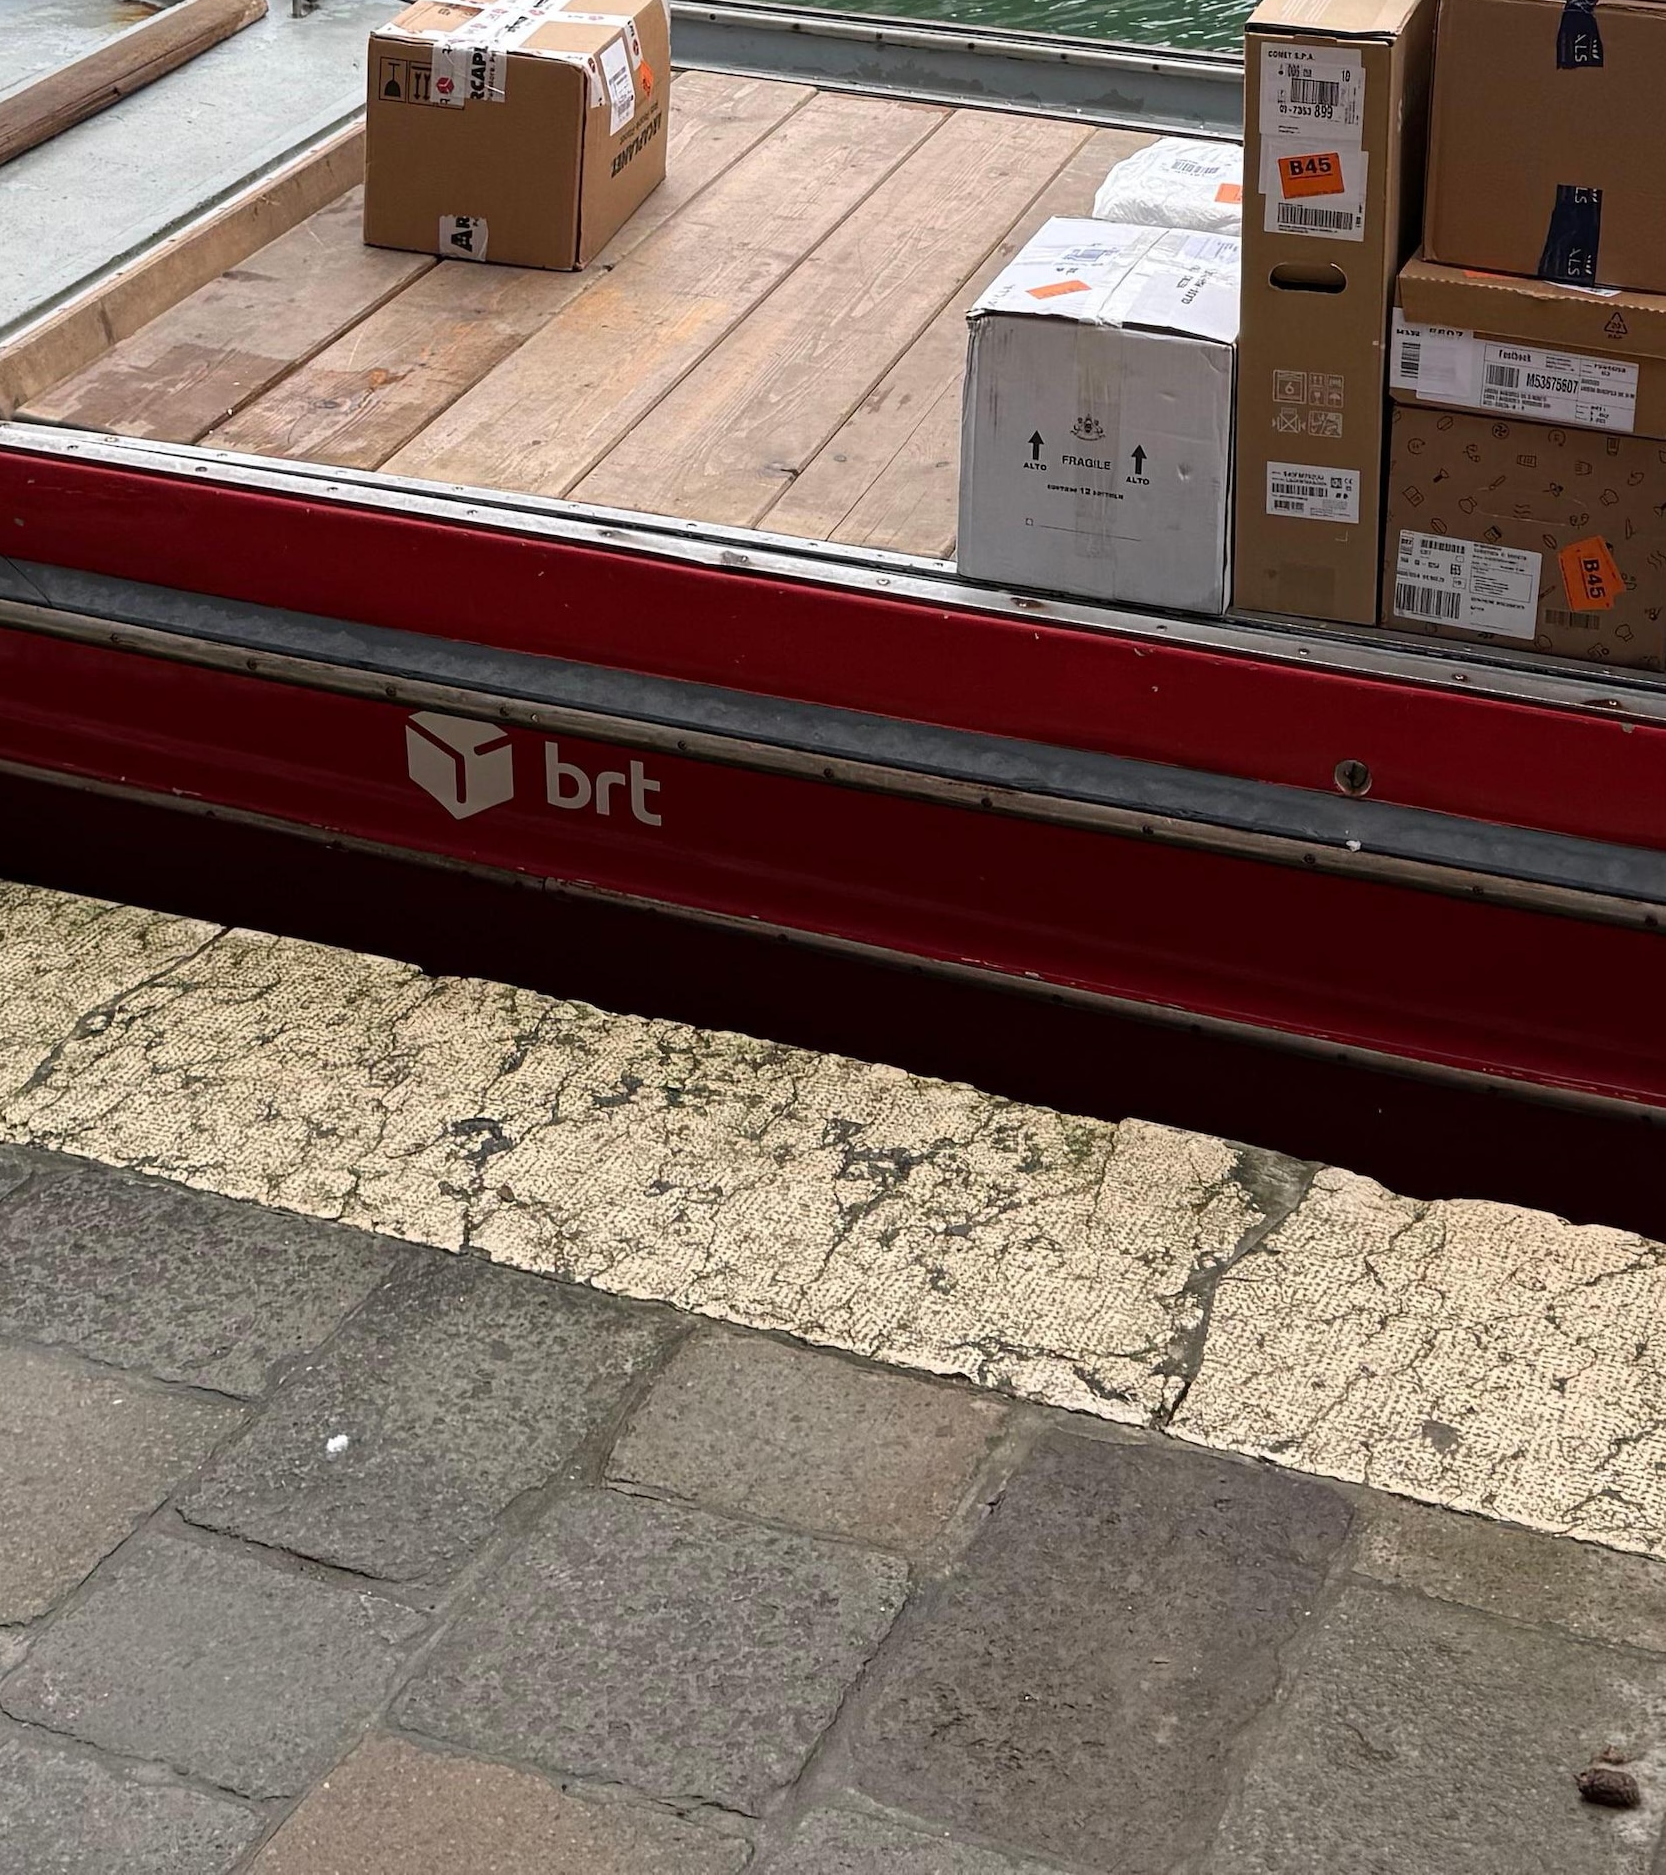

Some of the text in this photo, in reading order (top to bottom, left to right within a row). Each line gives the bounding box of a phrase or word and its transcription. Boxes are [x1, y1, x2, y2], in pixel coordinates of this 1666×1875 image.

[1289, 157, 1332, 176] B45
[1023, 462, 1047, 471] ALTO
[1062, 455, 1111, 470] FRAGILE
[1126, 476, 1150, 486] ALTO
[1080, 487, 1091, 495] 12
[1583, 558, 1606, 599] B45
[544, 740, 662, 827] brt
